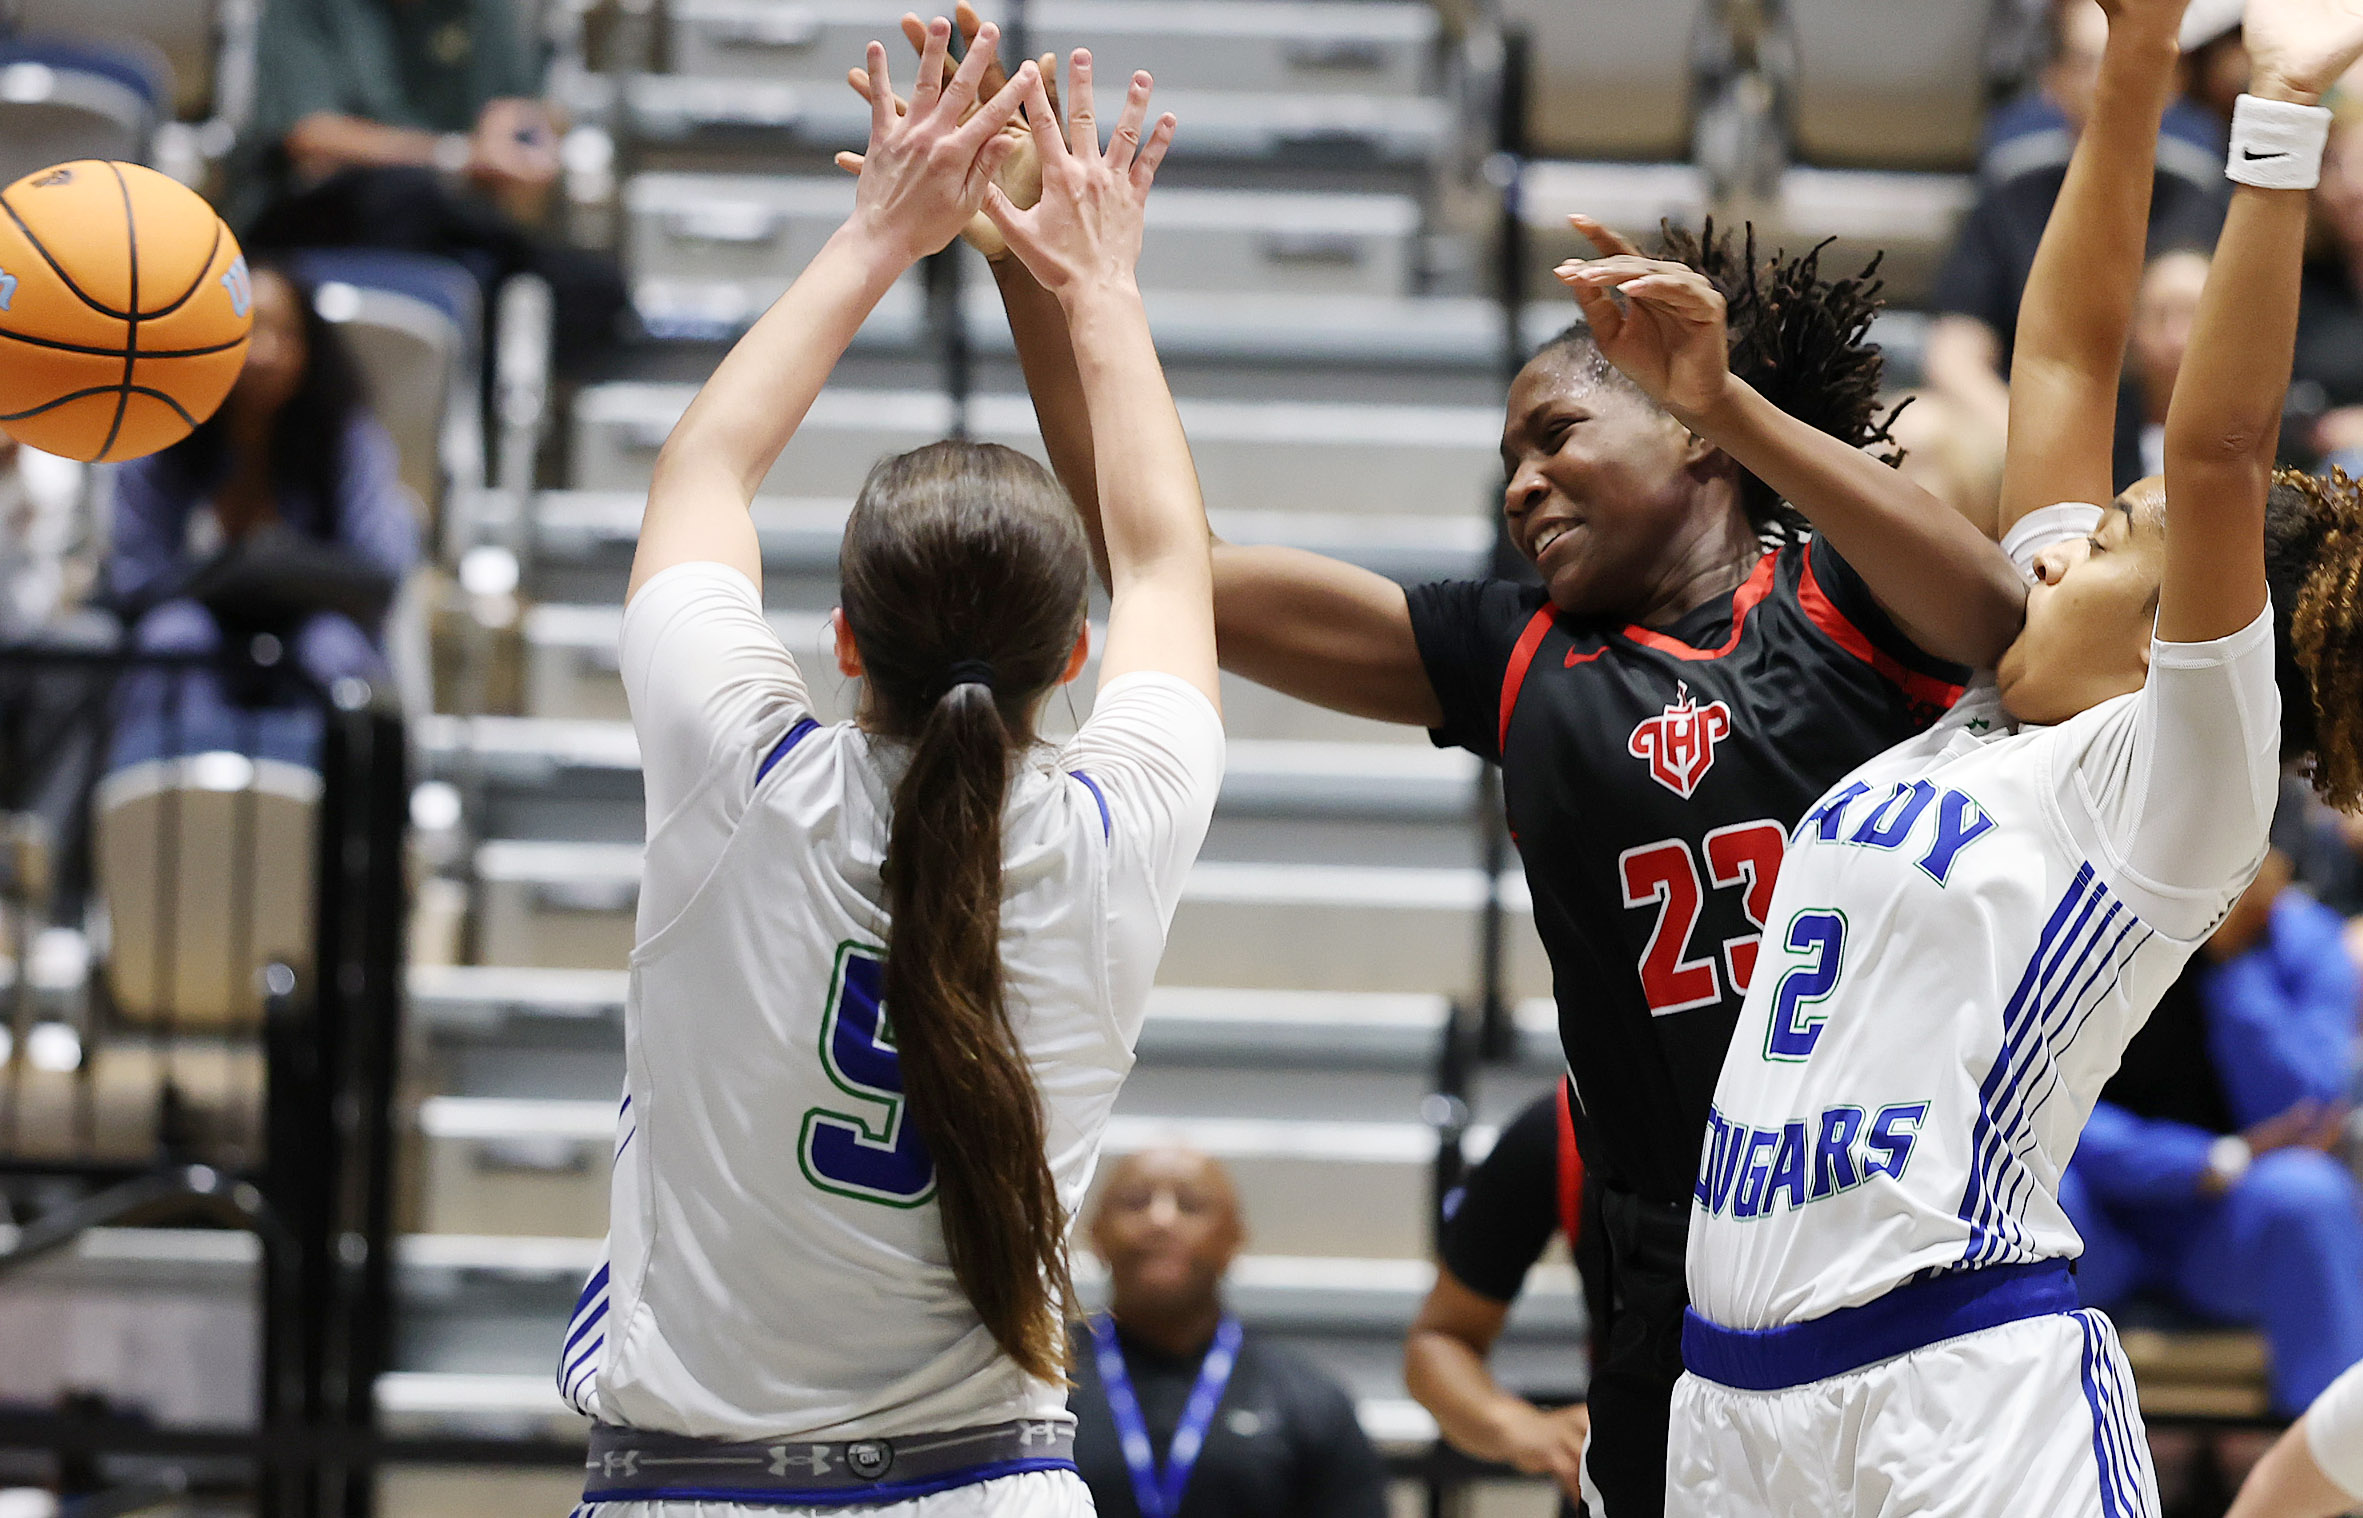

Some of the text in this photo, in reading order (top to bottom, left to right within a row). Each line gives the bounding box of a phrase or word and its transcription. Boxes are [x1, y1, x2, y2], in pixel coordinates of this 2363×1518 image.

[1790, 777, 1999, 889] ADY
[1619, 818, 1789, 1017] 23
[1763, 907, 1848, 1062] 2
[797, 939, 937, 1209] 5
[1694, 1100, 1932, 1222] OUGARS
